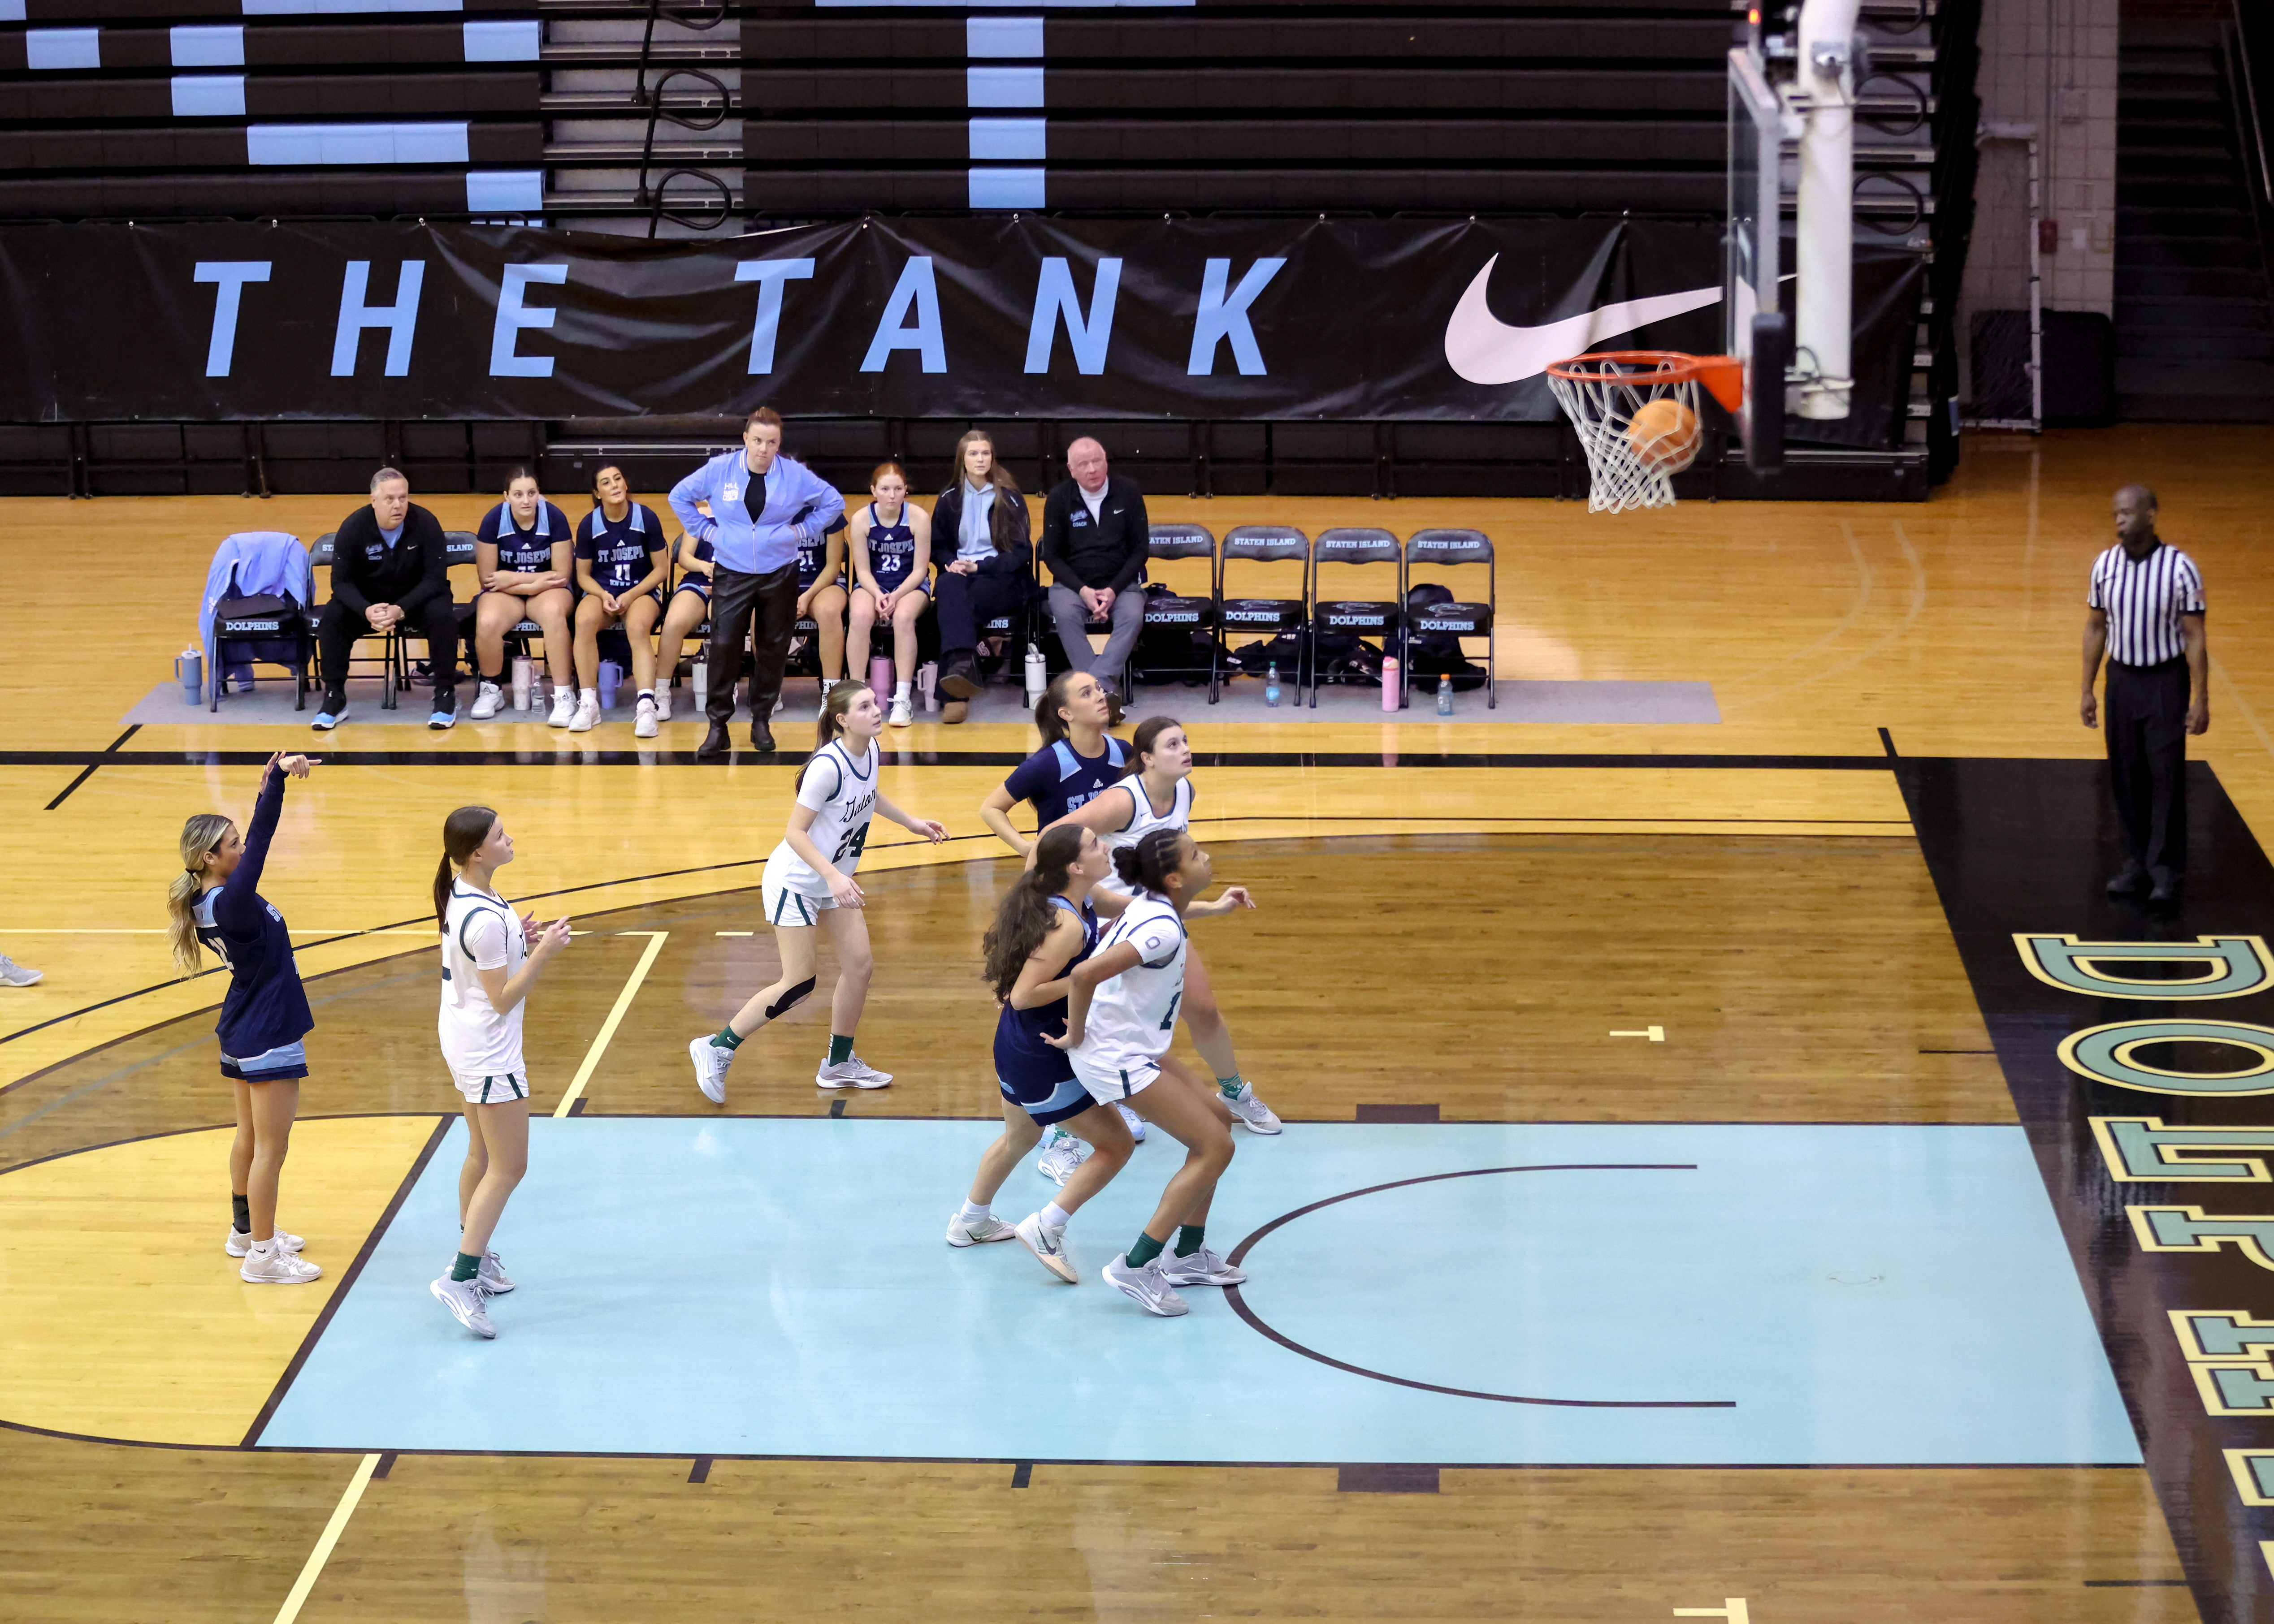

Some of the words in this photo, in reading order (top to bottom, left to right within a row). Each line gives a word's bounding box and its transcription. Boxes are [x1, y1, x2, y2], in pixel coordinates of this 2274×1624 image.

[193, 259, 569, 377] THE
[734, 255, 1288, 375] TANK
[1172, 536, 1203, 544] ISLAND
[1266, 538, 1296, 546] ISLAND
[1359, 540, 1390, 548] ISLAND
[1417, 540, 1448, 549] STATEN
[1449, 541, 1480, 549] ISLAND
[878, 539, 914, 553] JOSEPH
[500, 550, 513, 563] ST
[514, 547, 551, 564] JOSEPH
[598, 550, 609, 562] ST
[611, 545, 644, 561] JOSEPH
[881, 554, 901, 571] 23
[615, 564, 631, 581] 11
[1145, 613, 1199, 622] DOLPHINS
[1226, 611, 1280, 622] DOLPHINS
[1330, 615, 1384, 625] DOLPHINS
[226, 622, 280, 631] DOLPHINS
[1420, 621, 1474, 631] DOLPHINS
[832, 821, 870, 864] 24
